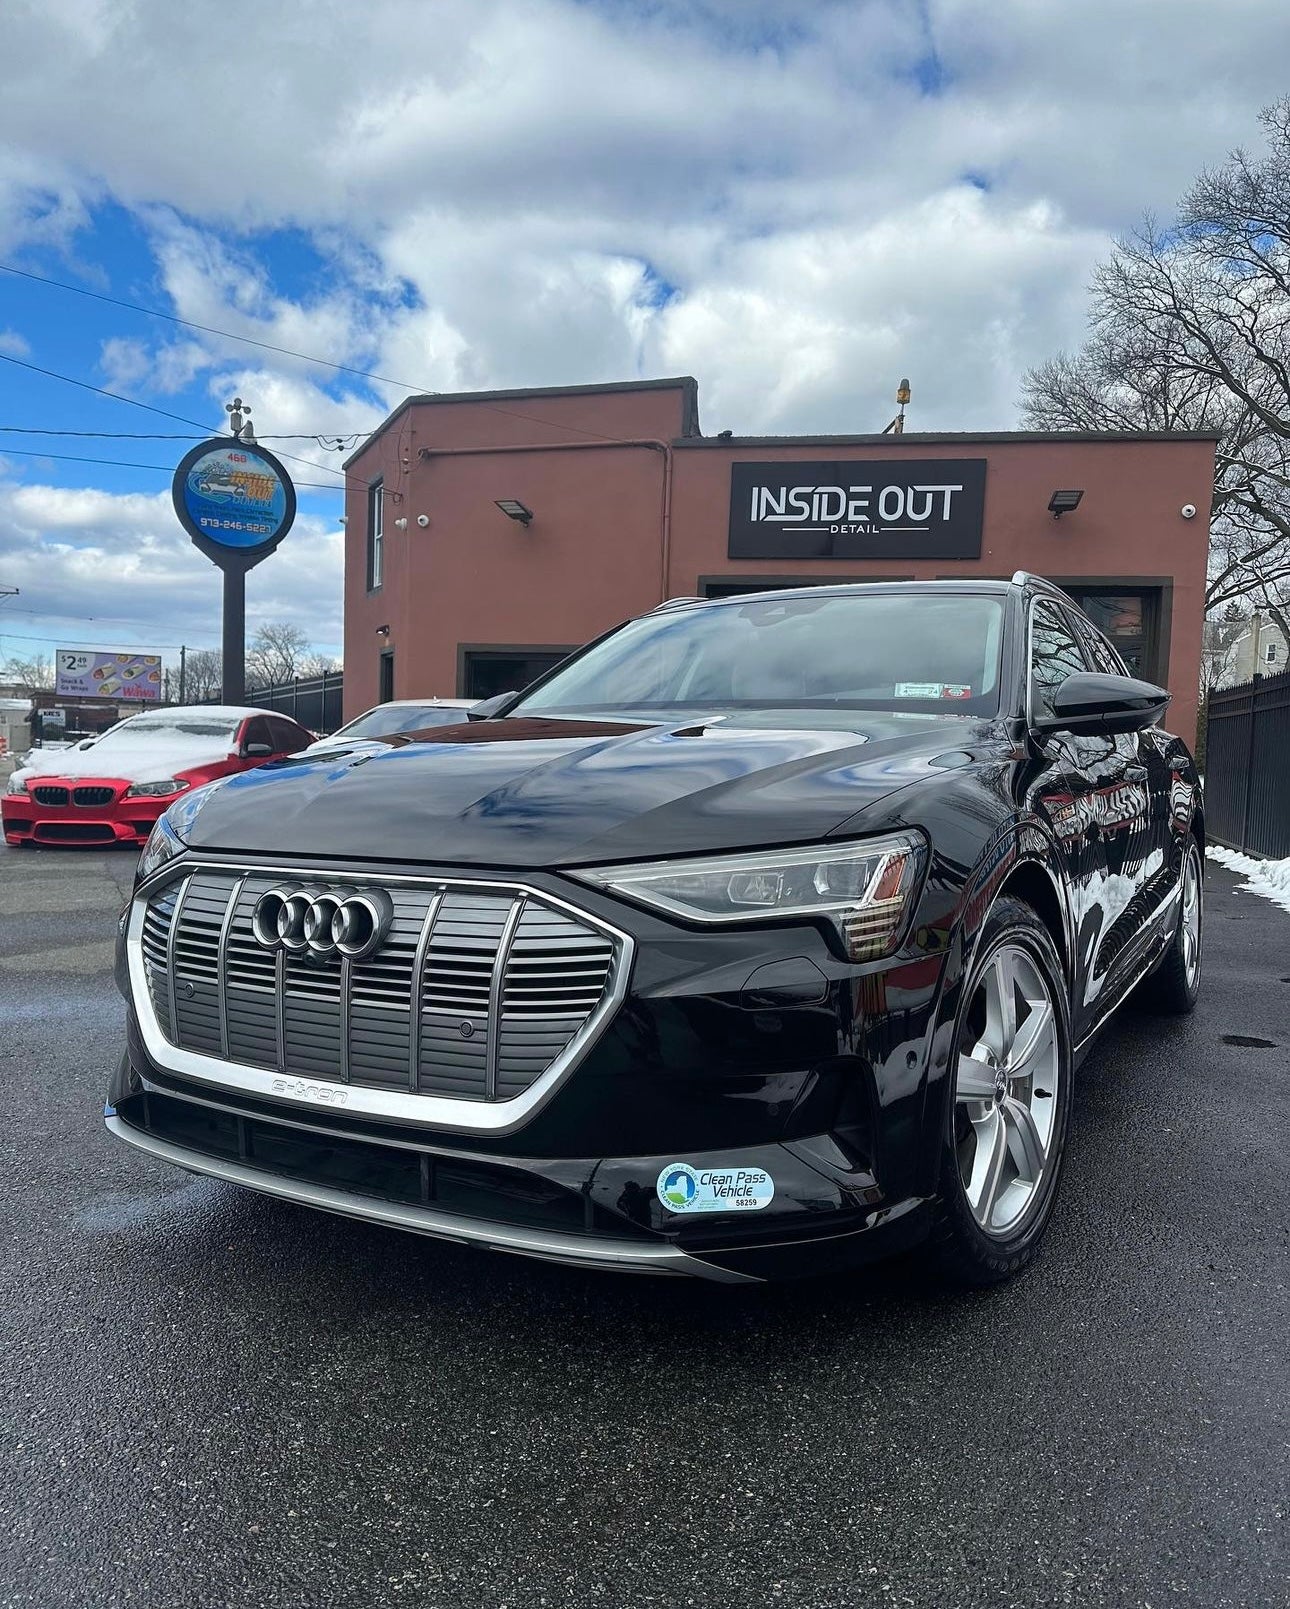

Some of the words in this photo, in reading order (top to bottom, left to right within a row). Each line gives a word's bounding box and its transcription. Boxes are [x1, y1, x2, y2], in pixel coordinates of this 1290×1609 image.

[750, 486, 872, 522] INSIDE
[878, 485, 963, 521] OUT
[200, 518, 271, 533] 973-246-5227
[830, 524, 880, 534] DETAIL
[122, 686, 156, 698] Wawa
[272, 1080, 348, 1104] e-tron
[700, 1173, 733, 1186] Clean
[736, 1172, 766, 1184] Pass
[713, 1185, 753, 1198] Vehicle
[736, 1198, 757, 1207] 58259
